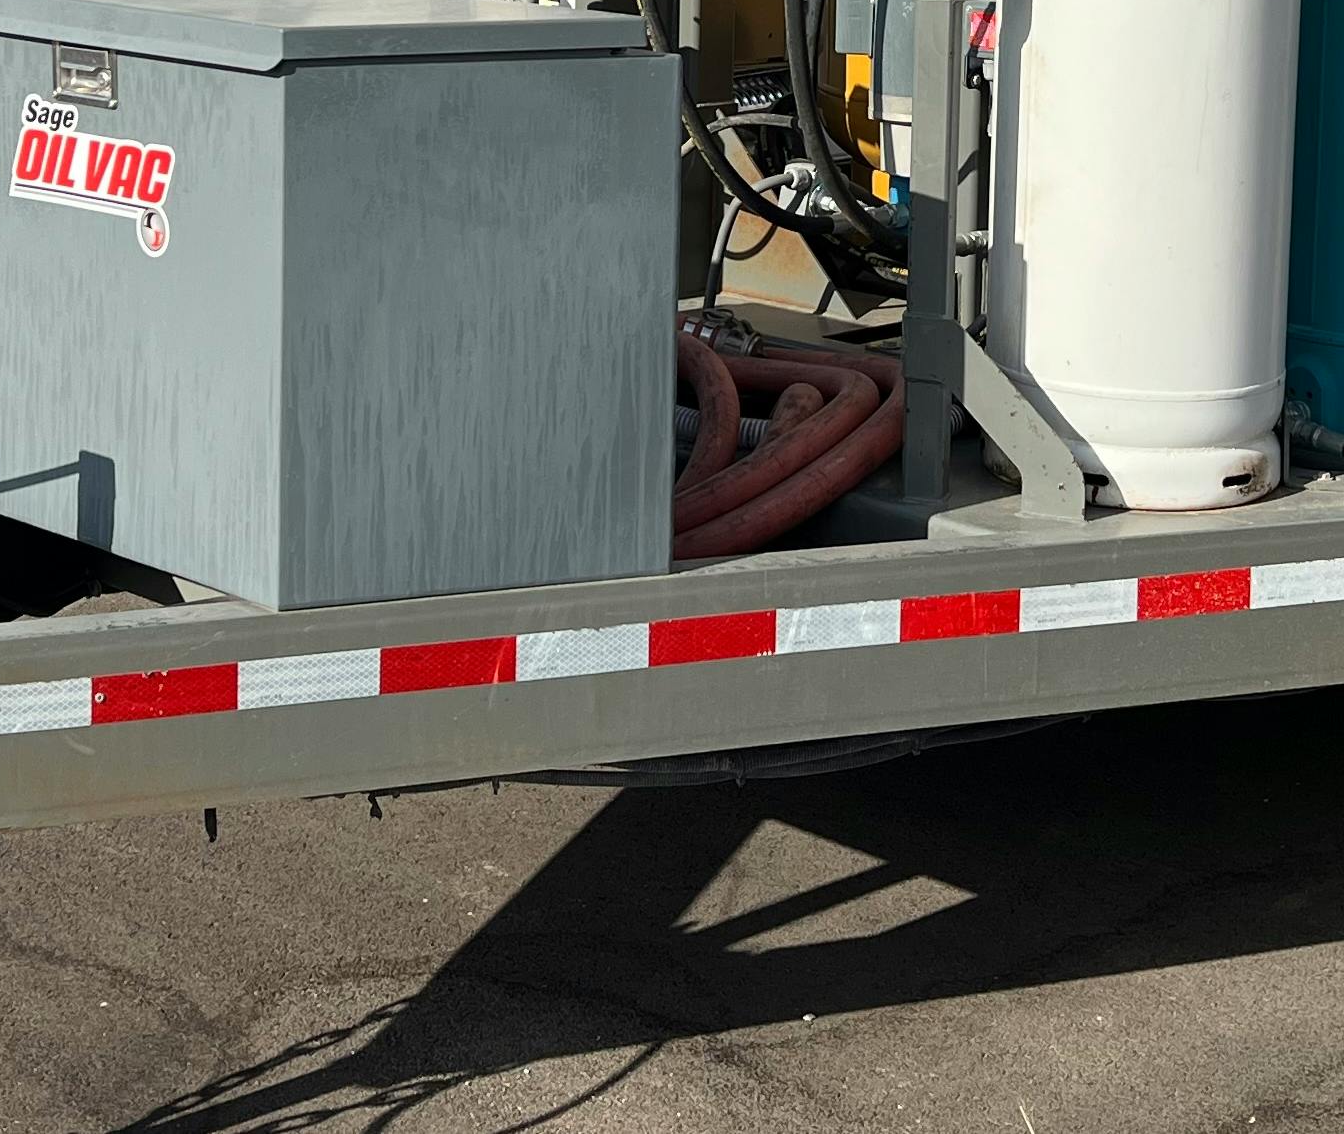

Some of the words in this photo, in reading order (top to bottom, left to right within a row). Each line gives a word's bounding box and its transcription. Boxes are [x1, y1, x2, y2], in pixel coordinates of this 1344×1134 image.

[25, 99, 75, 131] Sage
[15, 129, 77, 187] OIL
[84, 140, 172, 203] VAC
